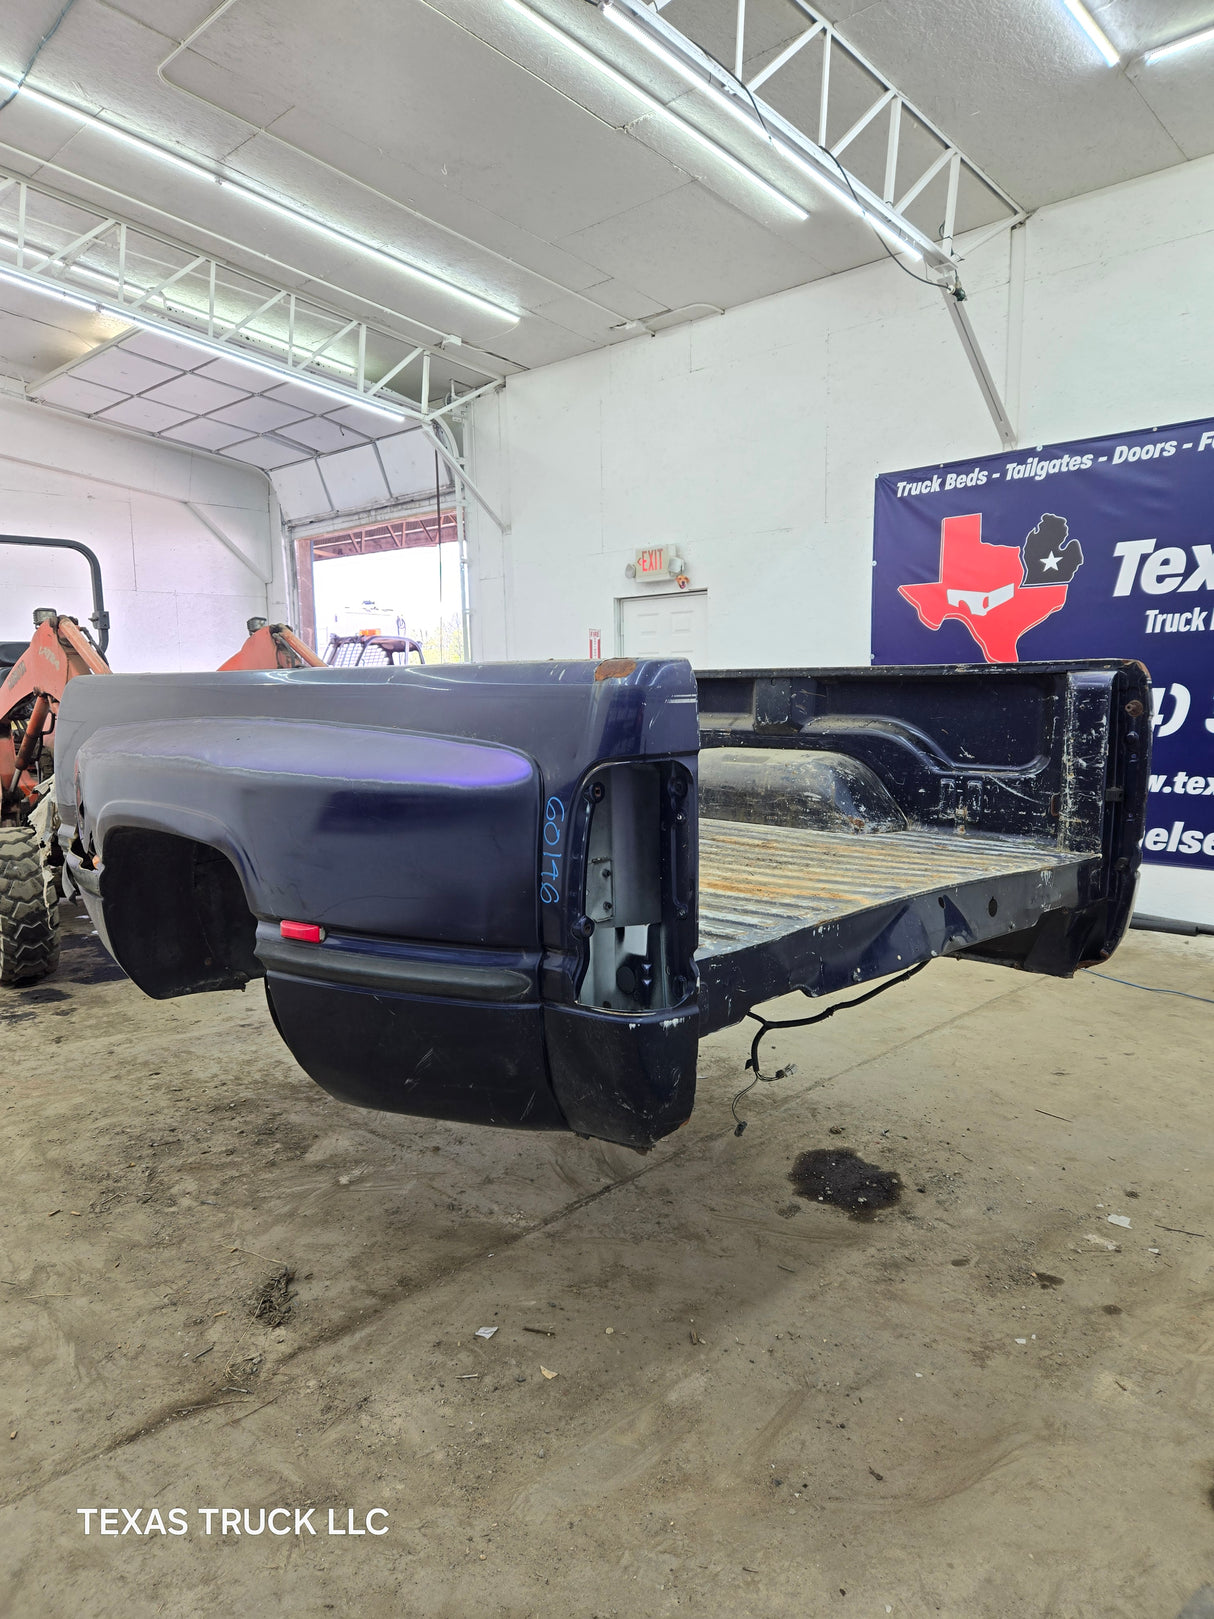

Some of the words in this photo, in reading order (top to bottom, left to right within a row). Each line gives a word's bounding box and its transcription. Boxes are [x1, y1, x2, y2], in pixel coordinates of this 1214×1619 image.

[897, 474, 943, 498] Truck
[944, 467, 988, 491] Beds
[1005, 453, 1094, 481] Tailgates
[1112, 440, 1178, 465] Doors
[641, 548, 664, 572] EXIT
[1145, 606, 1209, 634] Truck
[540, 796, 565, 904] 60146
